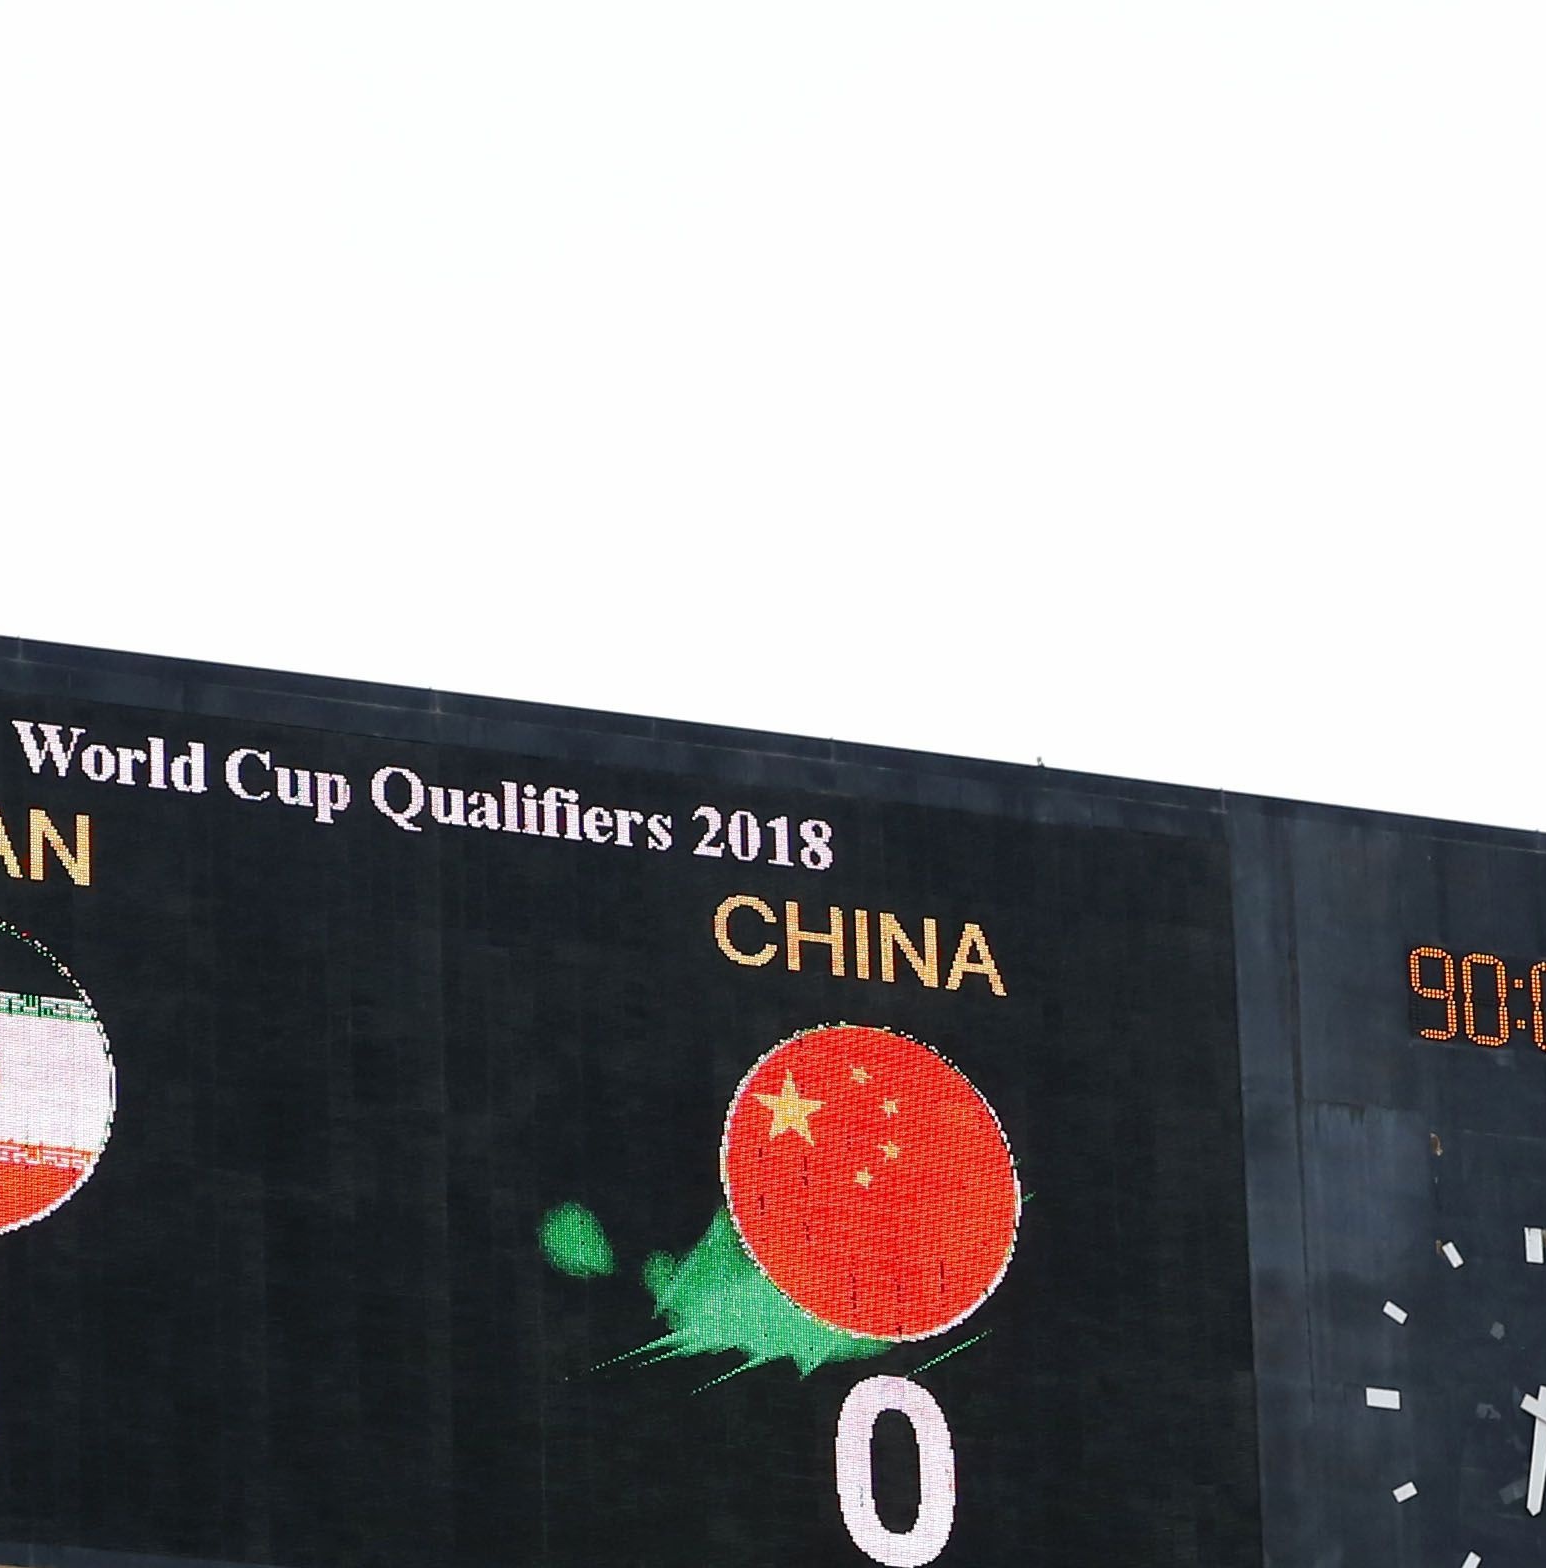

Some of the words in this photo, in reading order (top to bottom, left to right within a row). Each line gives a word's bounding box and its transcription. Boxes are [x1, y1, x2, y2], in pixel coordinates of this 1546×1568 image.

[11, 720, 208, 794] World
[225, 748, 351, 824] Cup
[371, 766, 672, 851] Qualifiers
[691, 805, 833, 871] 2018
[714, 894, 1007, 997] CHINA
[835, 1373, 956, 1568] 0
